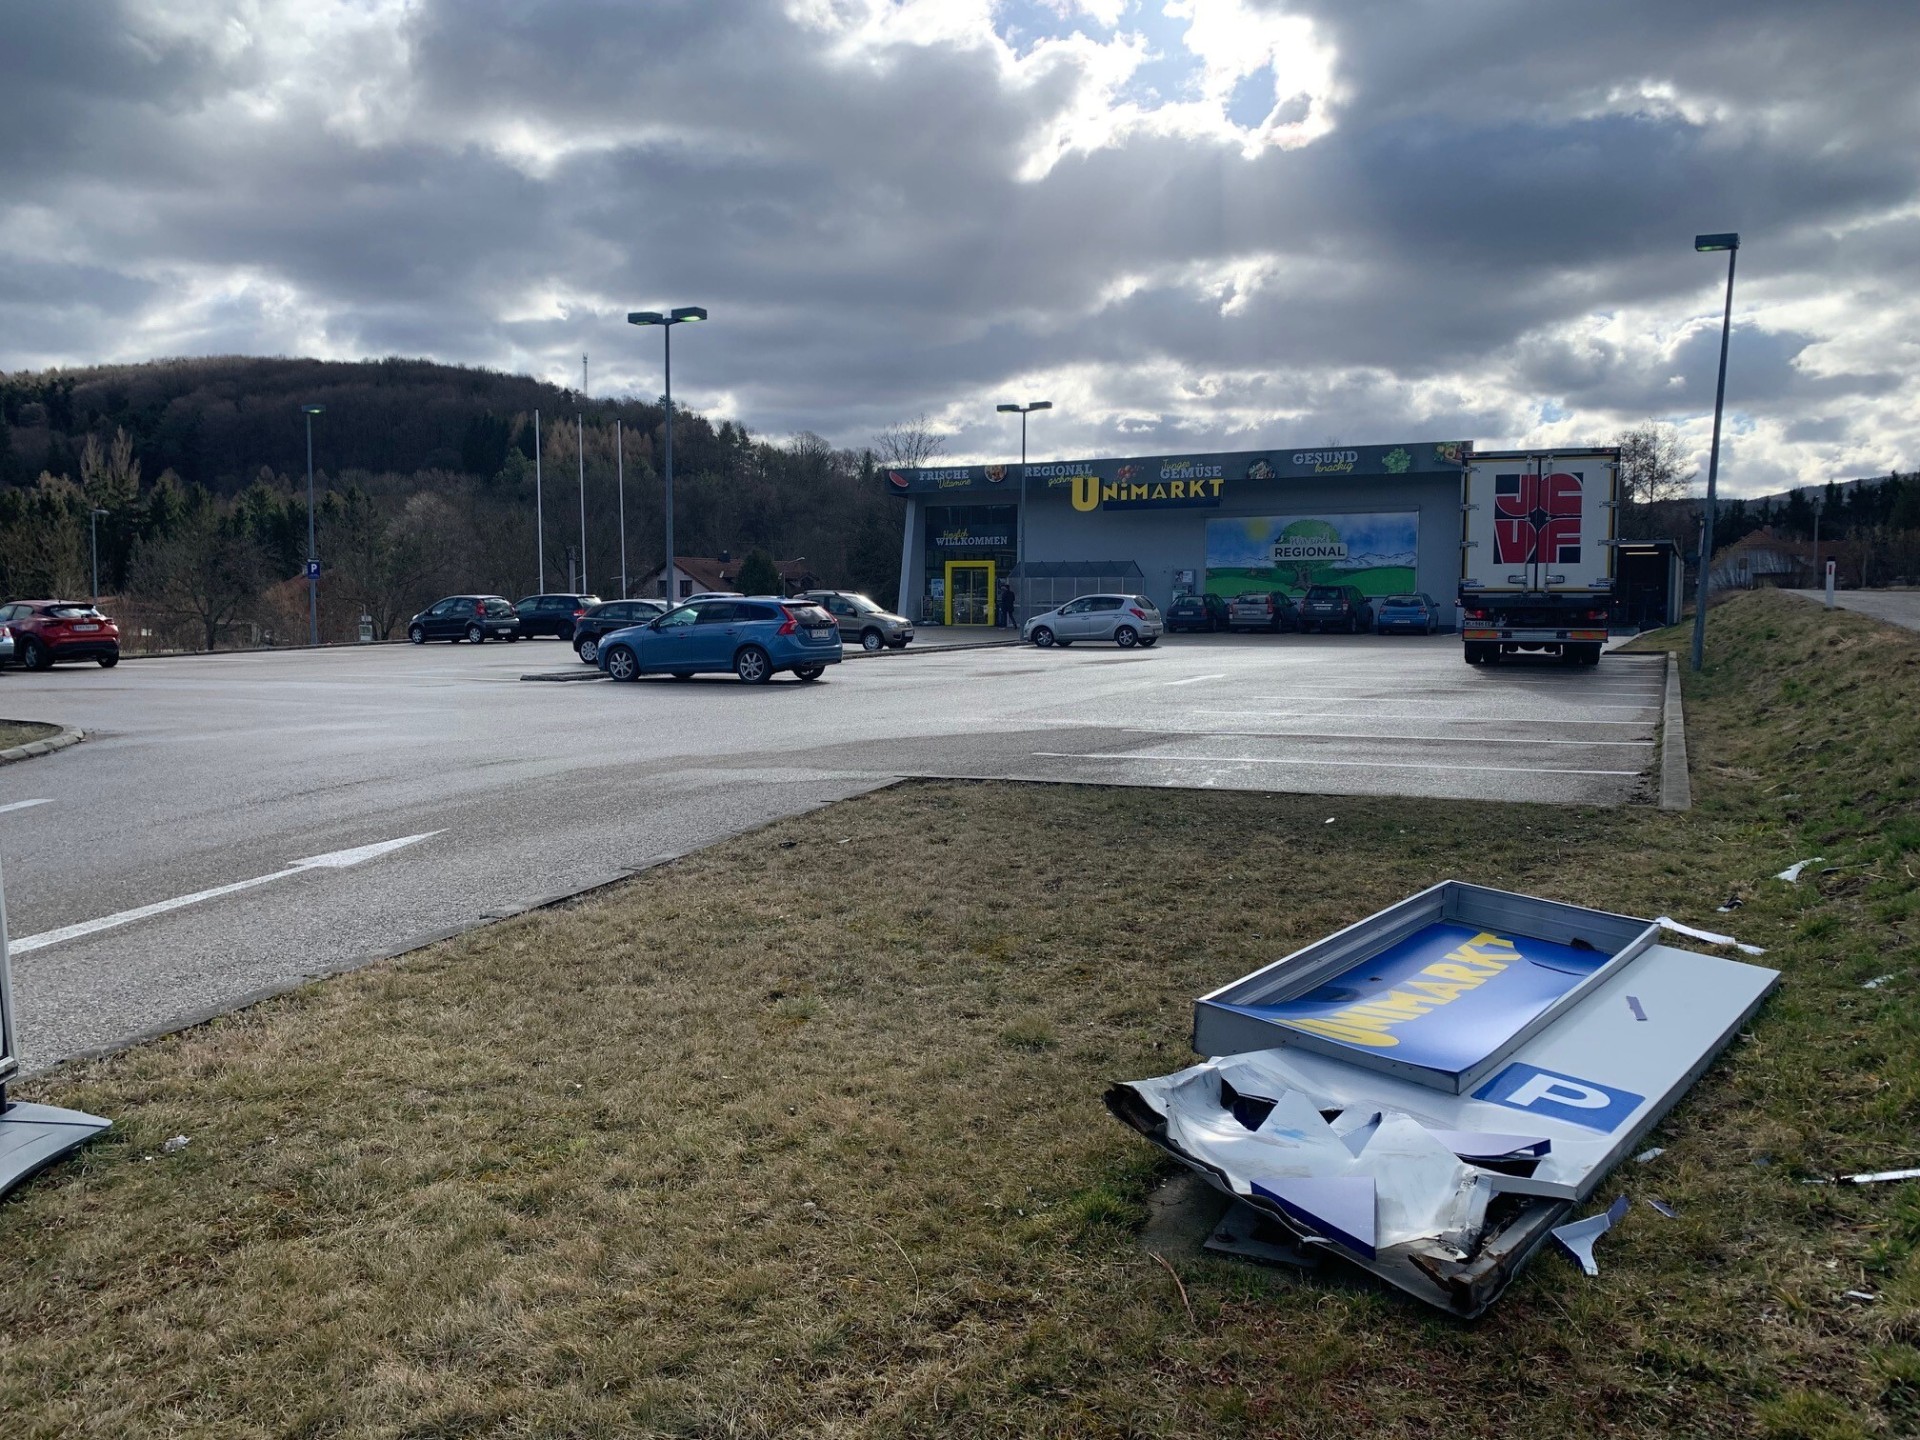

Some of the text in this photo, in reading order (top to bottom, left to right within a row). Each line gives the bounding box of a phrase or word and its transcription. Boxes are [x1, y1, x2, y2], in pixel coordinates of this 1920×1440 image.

[1292, 451, 1358, 465] GESUND
[919, 470, 969, 480] FRISCHE
[1025, 464, 1092, 477] REGIONAL
[1160, 464, 1222, 479] GEMÜSE
[938, 478, 972, 489] Vitamine
[936, 537, 1008, 546] WILLKOMMEN
[1274, 547, 1345, 557] REGIONAL
[311, 563, 317, 573] P
[1271, 932, 1522, 1047] UNIMARKT
[1506, 1073, 1611, 1109] P
